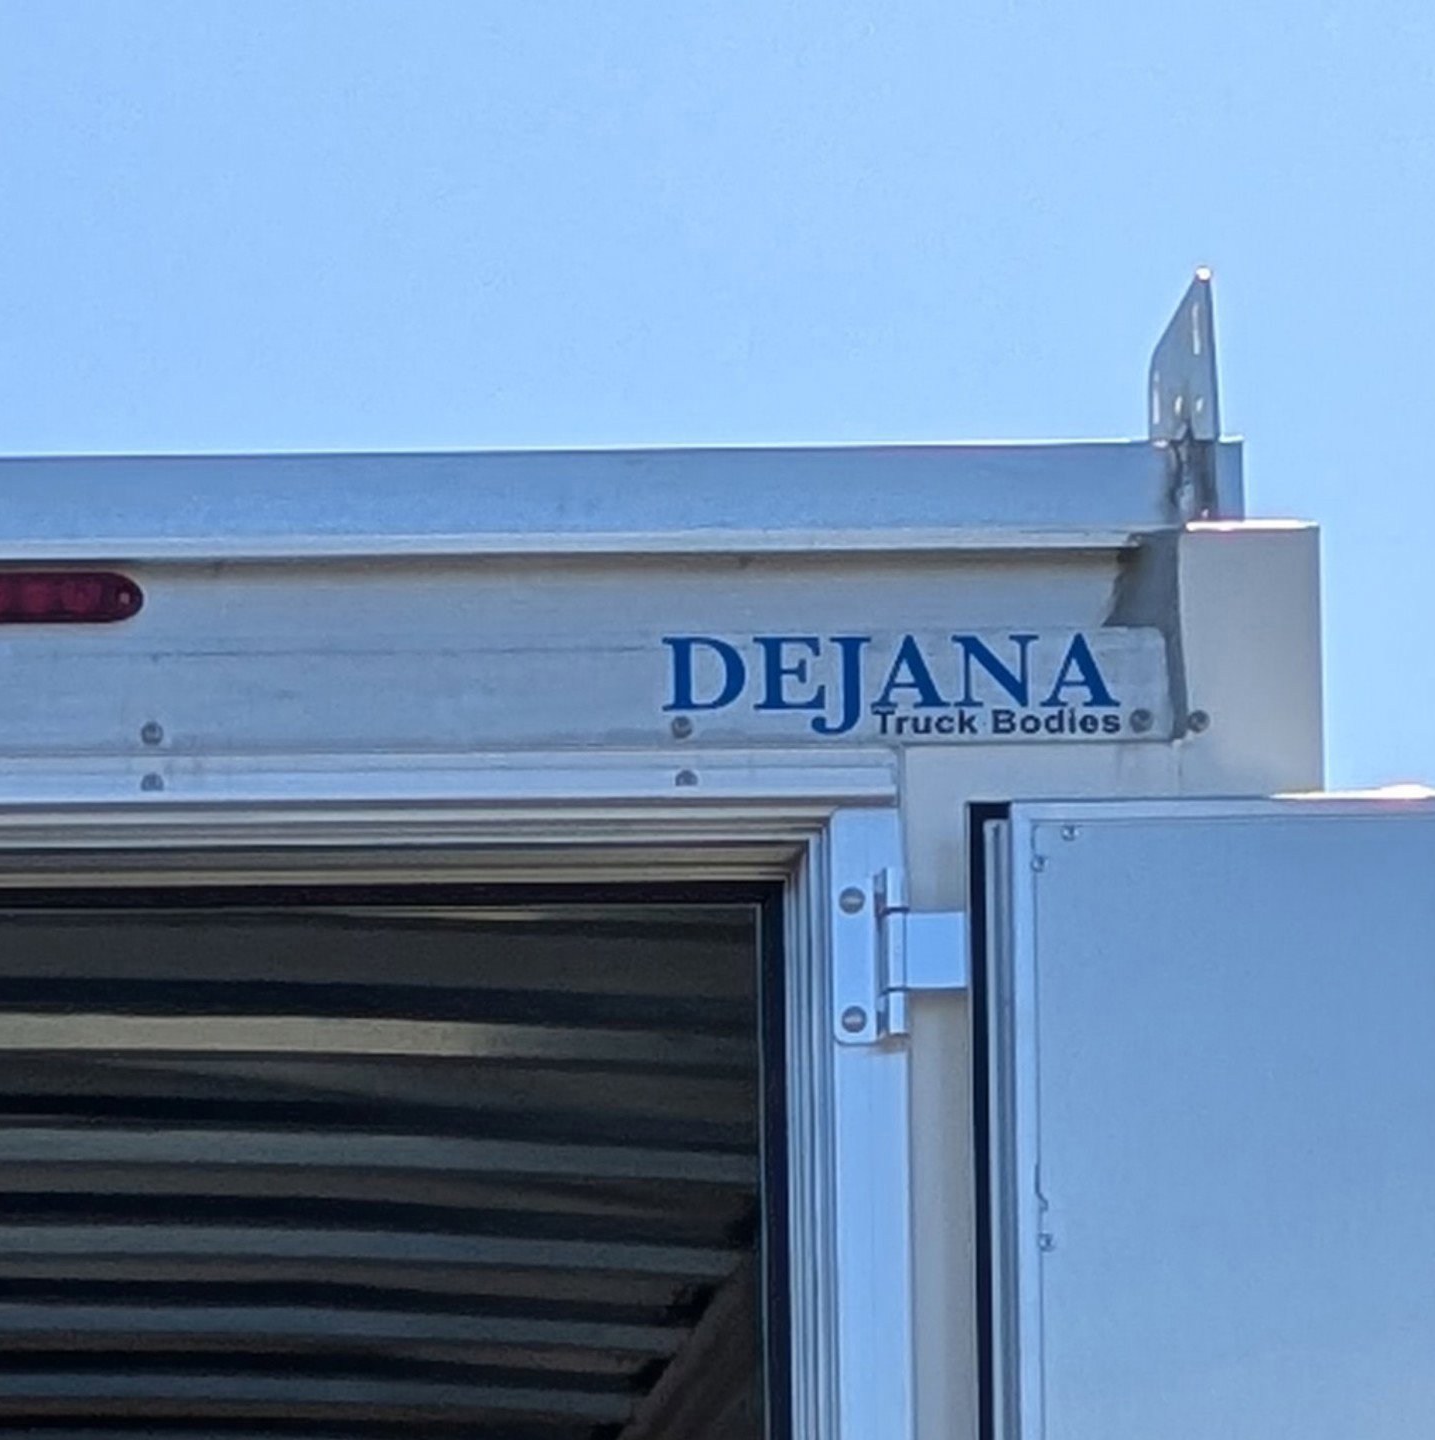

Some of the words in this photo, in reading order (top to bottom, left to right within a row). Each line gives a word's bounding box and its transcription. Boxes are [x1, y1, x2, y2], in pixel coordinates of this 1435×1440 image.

[661, 633, 1121, 735] DEJANA
[871, 705, 978, 735] Truck
[991, 707, 1121, 734] Bodies
